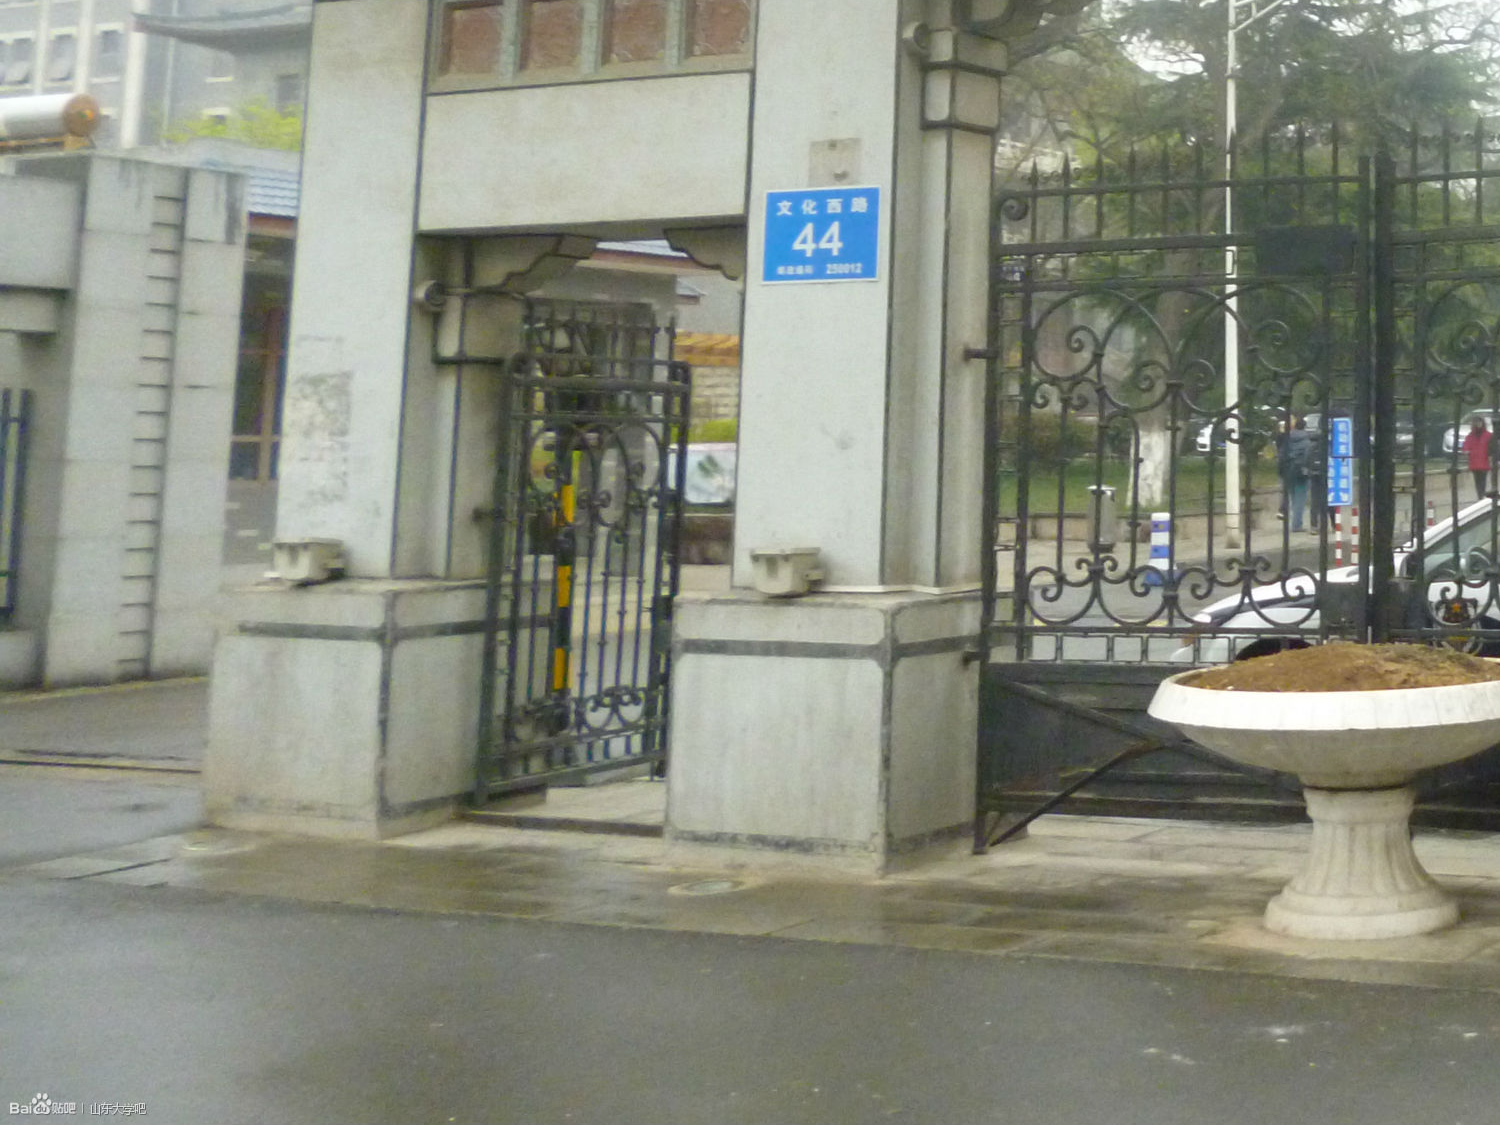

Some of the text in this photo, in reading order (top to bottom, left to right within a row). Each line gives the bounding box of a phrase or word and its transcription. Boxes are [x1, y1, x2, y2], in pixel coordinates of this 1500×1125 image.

[776, 196, 869, 216] 文化西路
[792, 220, 844, 258] 44
